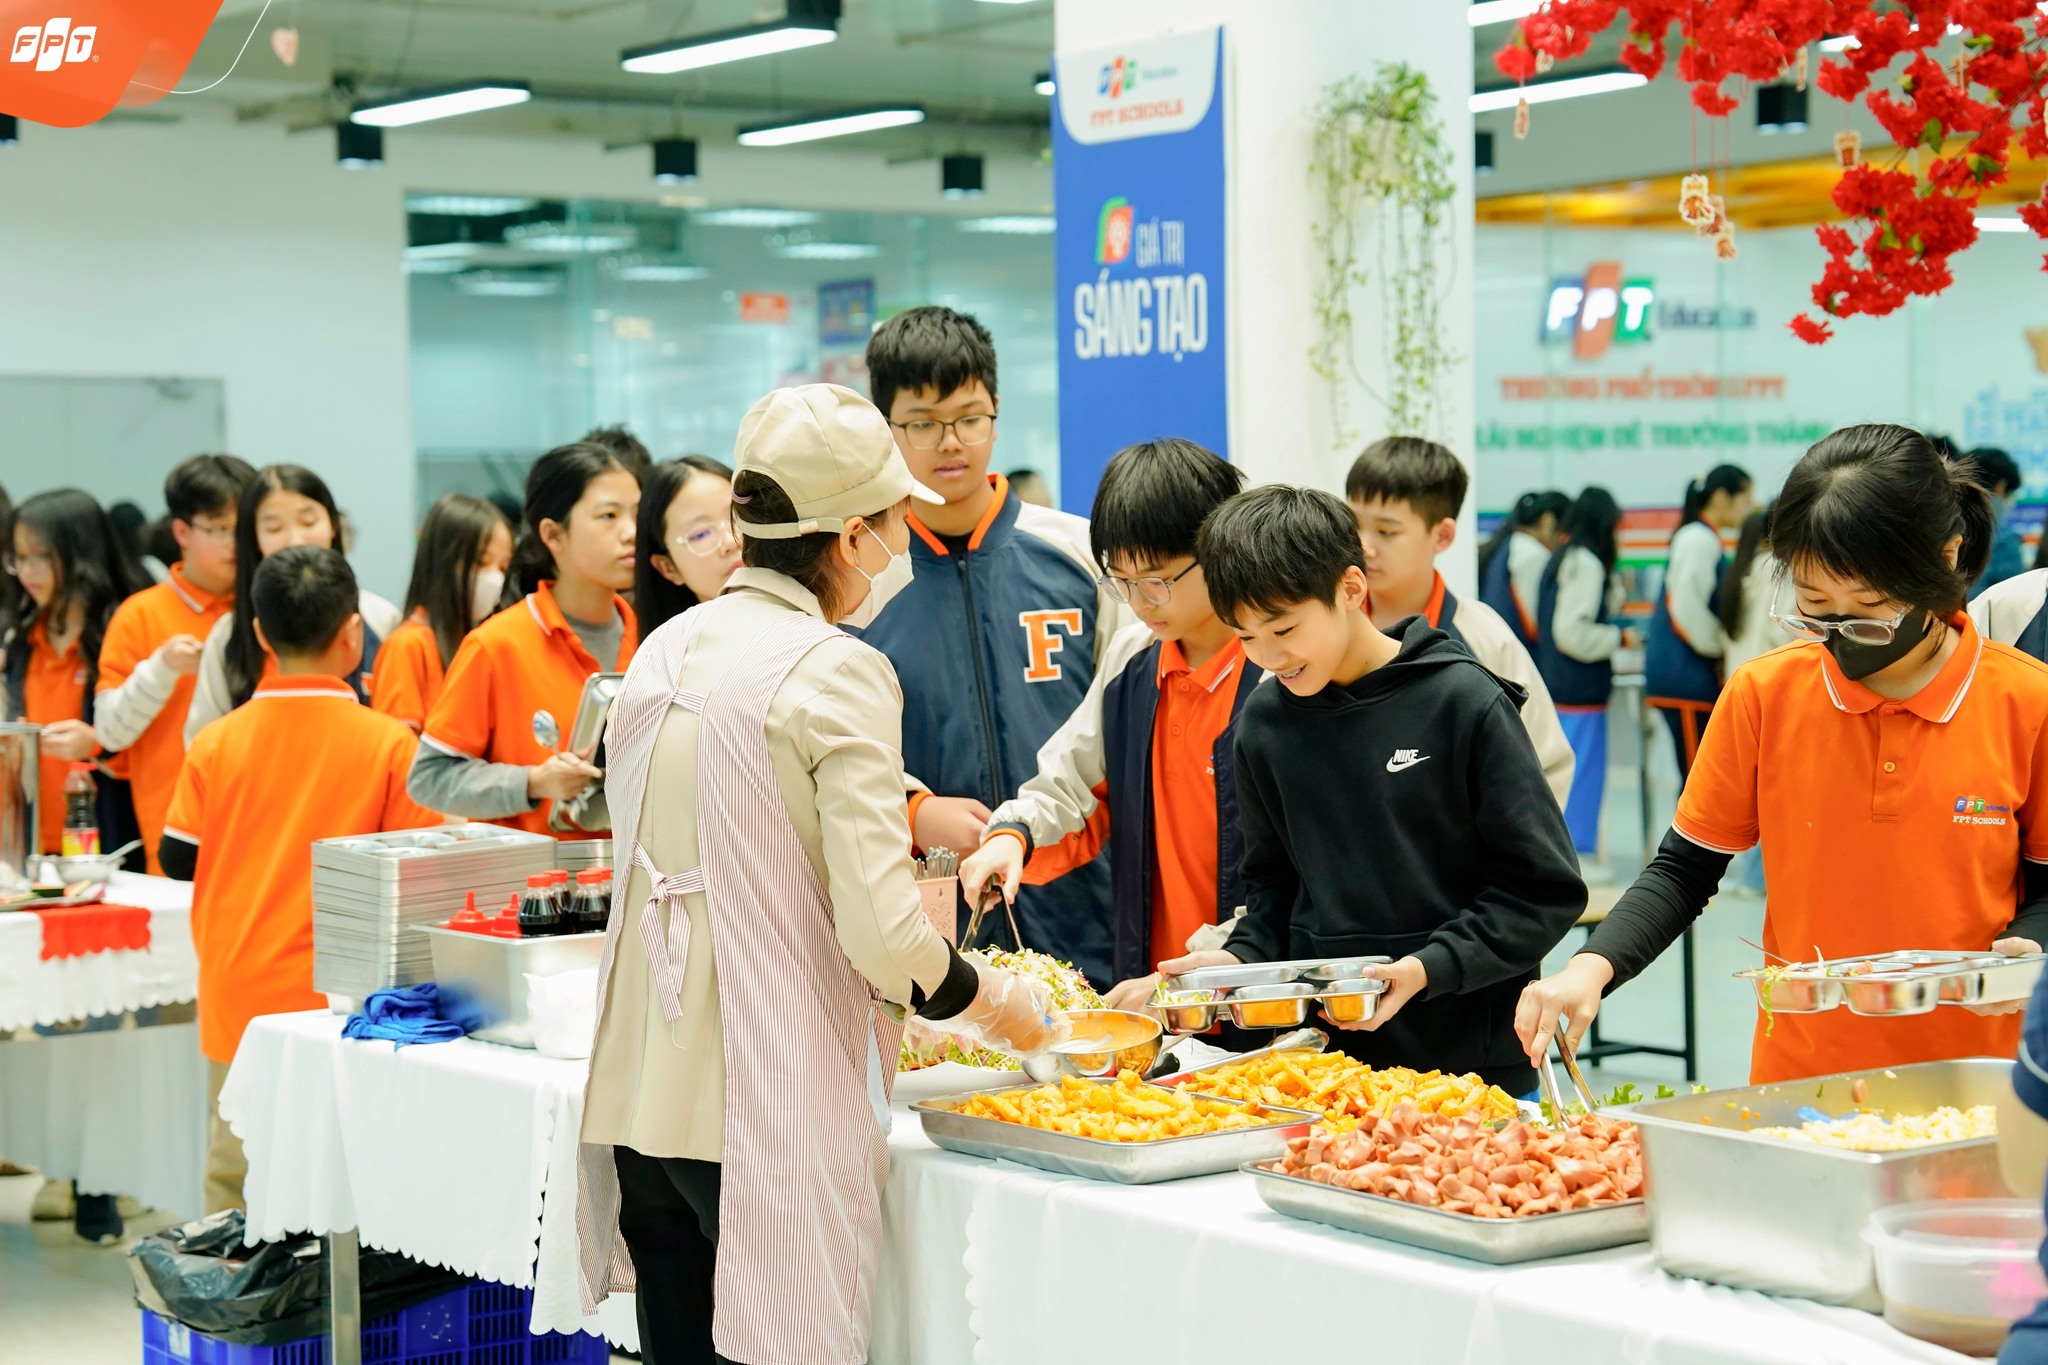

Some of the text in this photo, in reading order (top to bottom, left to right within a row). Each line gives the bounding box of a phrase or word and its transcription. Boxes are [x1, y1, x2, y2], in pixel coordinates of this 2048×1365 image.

[1136, 216, 1185, 268] GIÁ TRỊ
[1074, 267, 1208, 363] SÁNG TẠO
[1019, 608, 1083, 683] F
[1393, 749, 1419, 762] NIKE
[1953, 815, 2006, 825] FPT SCHOOLS
[1955, 797, 1985, 812] FPT
